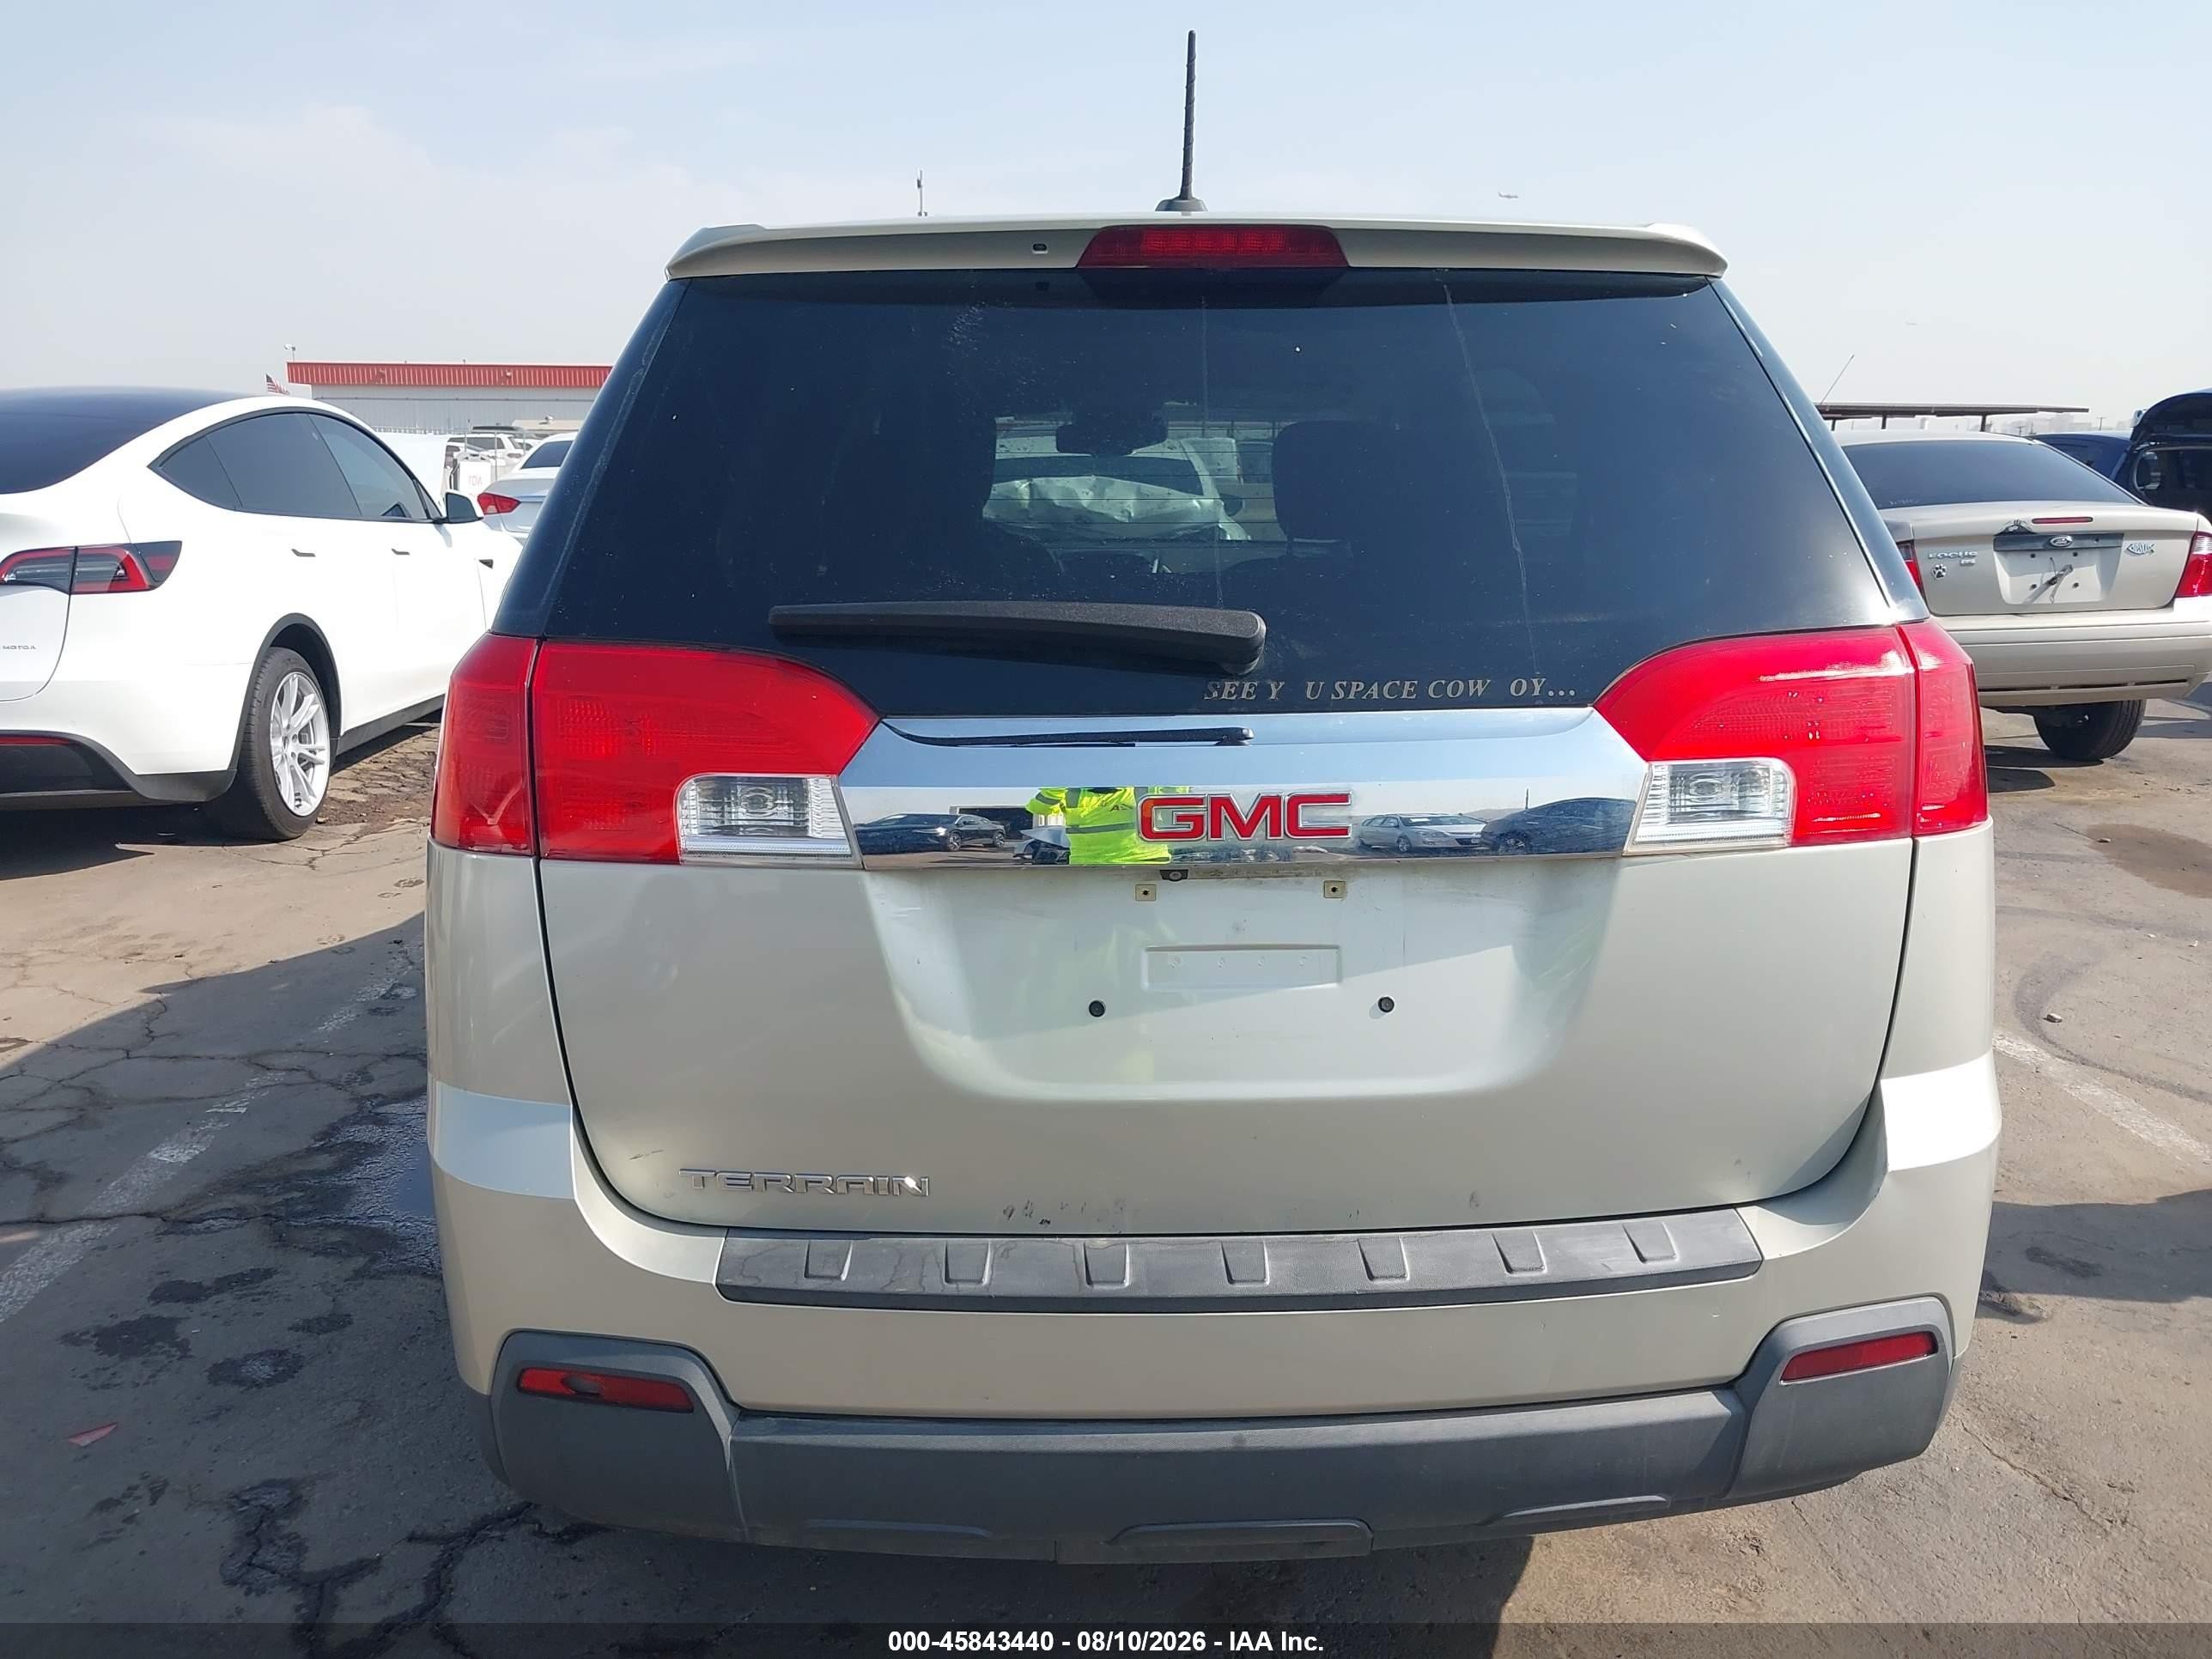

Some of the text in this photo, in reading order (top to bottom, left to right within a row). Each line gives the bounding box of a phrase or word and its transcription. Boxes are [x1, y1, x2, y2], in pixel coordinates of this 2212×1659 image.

[1204, 681, 1258, 700] SEE
[1331, 679, 1418, 700] SPACE
[1138, 792, 1352, 842] GMC
[678, 1169, 930, 1196] TERRAIN
